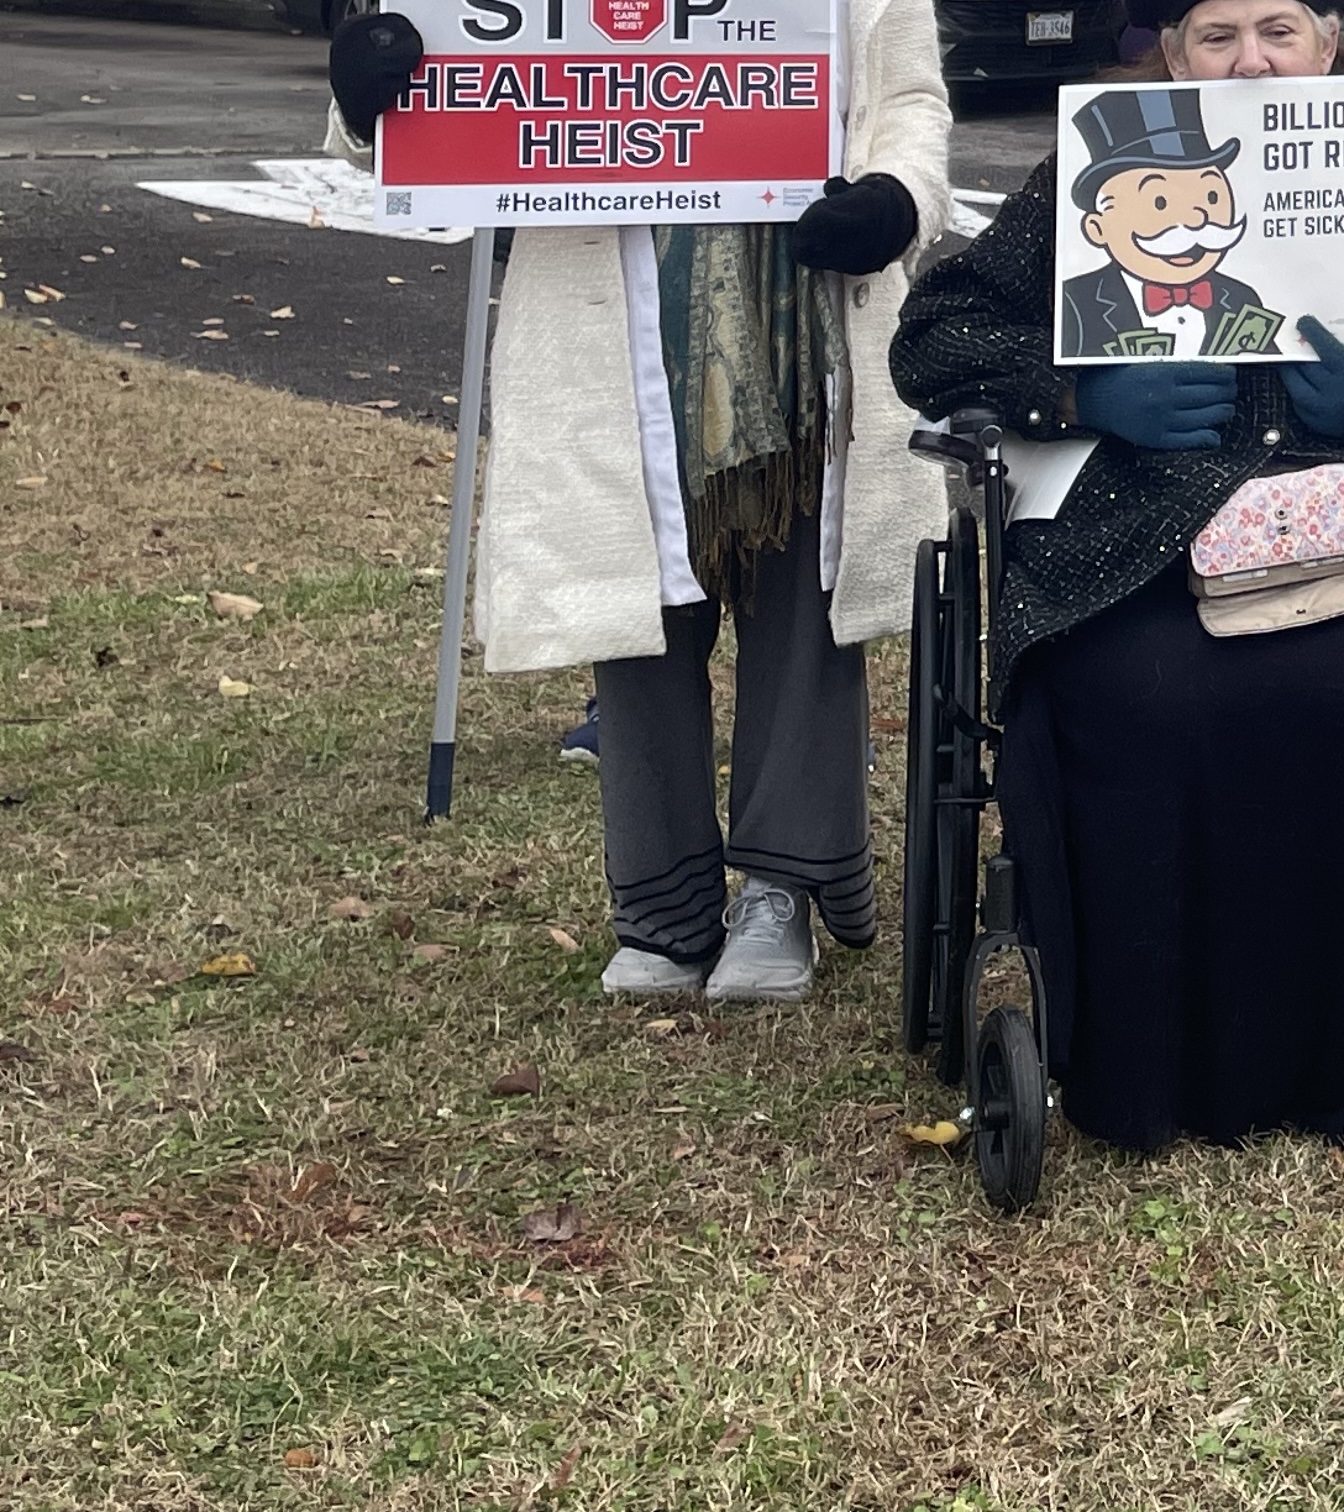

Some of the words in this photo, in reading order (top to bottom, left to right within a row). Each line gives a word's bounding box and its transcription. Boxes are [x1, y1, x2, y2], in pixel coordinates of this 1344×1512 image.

[608, 1, 649, 11] HEALTH
[613, 11, 641, 20] CARE
[613, 21, 644, 31] HEIST
[717, 20, 777, 42] THE
[398, 62, 818, 112] HEALTHCARE
[518, 121, 704, 170] HEIST
[1262, 141, 1314, 172] GOT
[496, 190, 722, 213] #HealthcareHeist
[1262, 217, 1299, 239] GET
